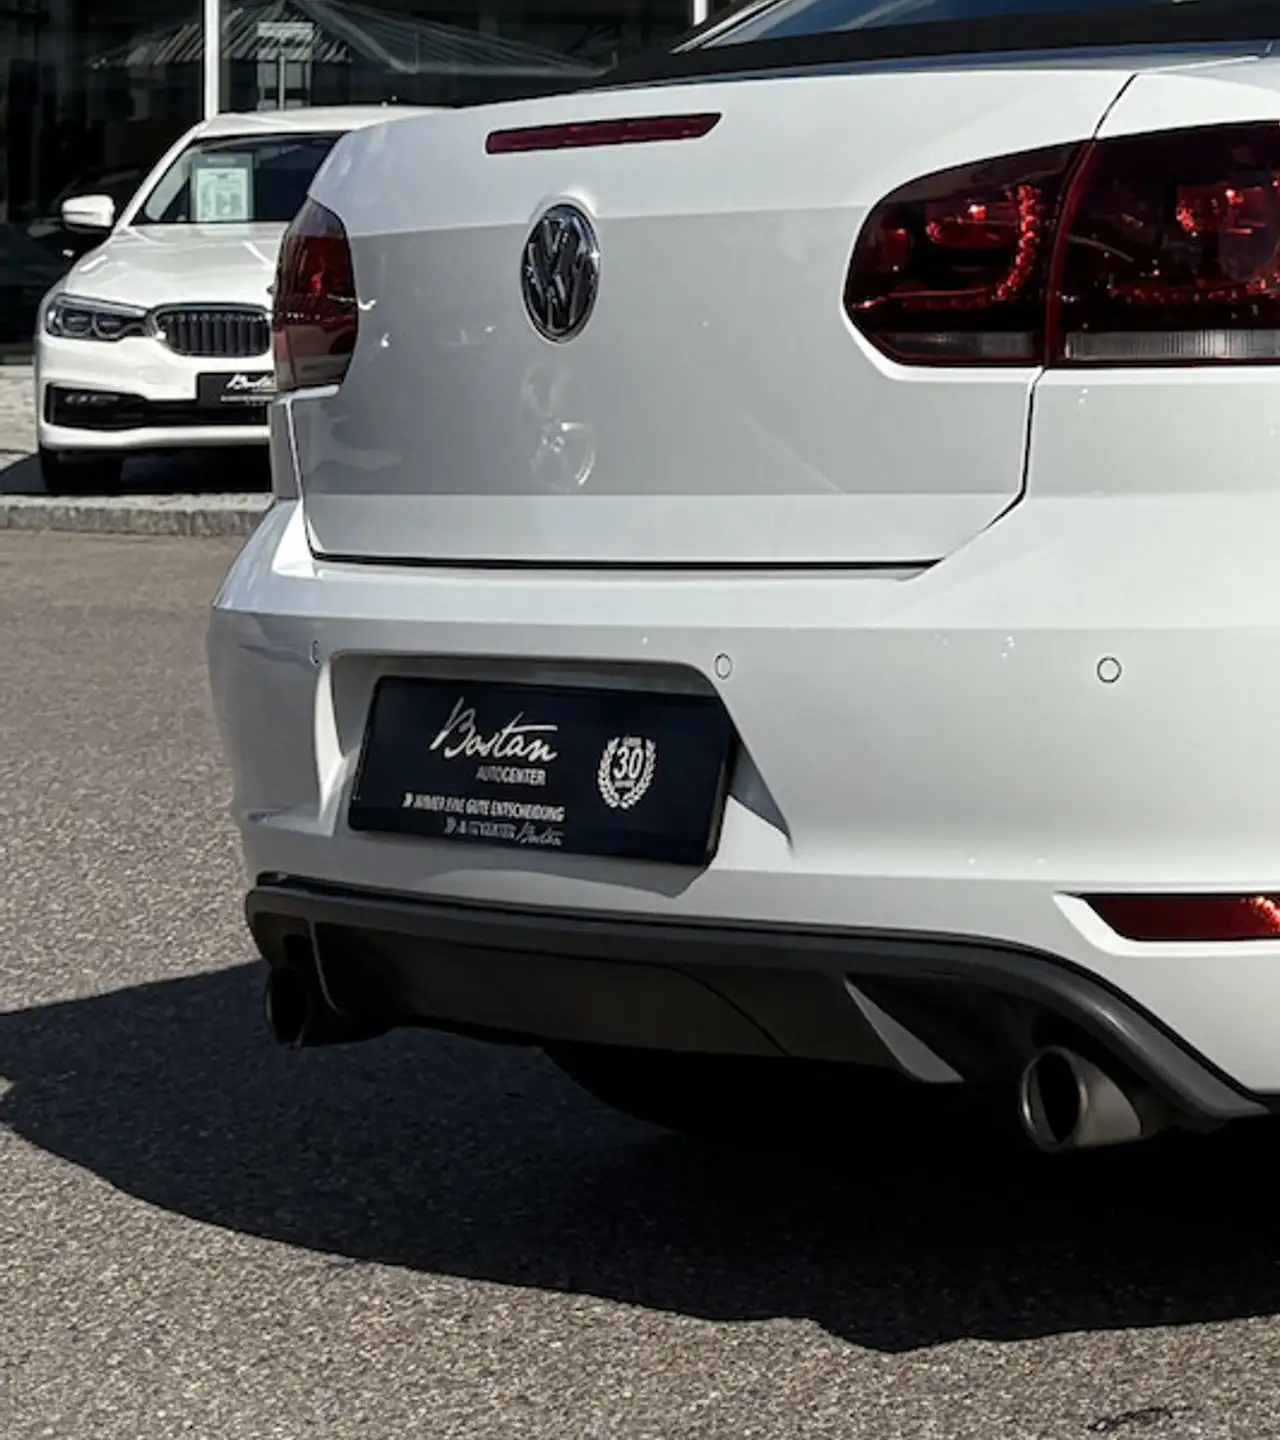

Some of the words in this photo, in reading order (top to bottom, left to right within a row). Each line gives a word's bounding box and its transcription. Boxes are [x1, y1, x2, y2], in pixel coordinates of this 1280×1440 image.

[429, 695, 558, 762] Bostan
[475, 764, 547, 786] AUTOCENTER
[612, 745, 645, 779] 30
